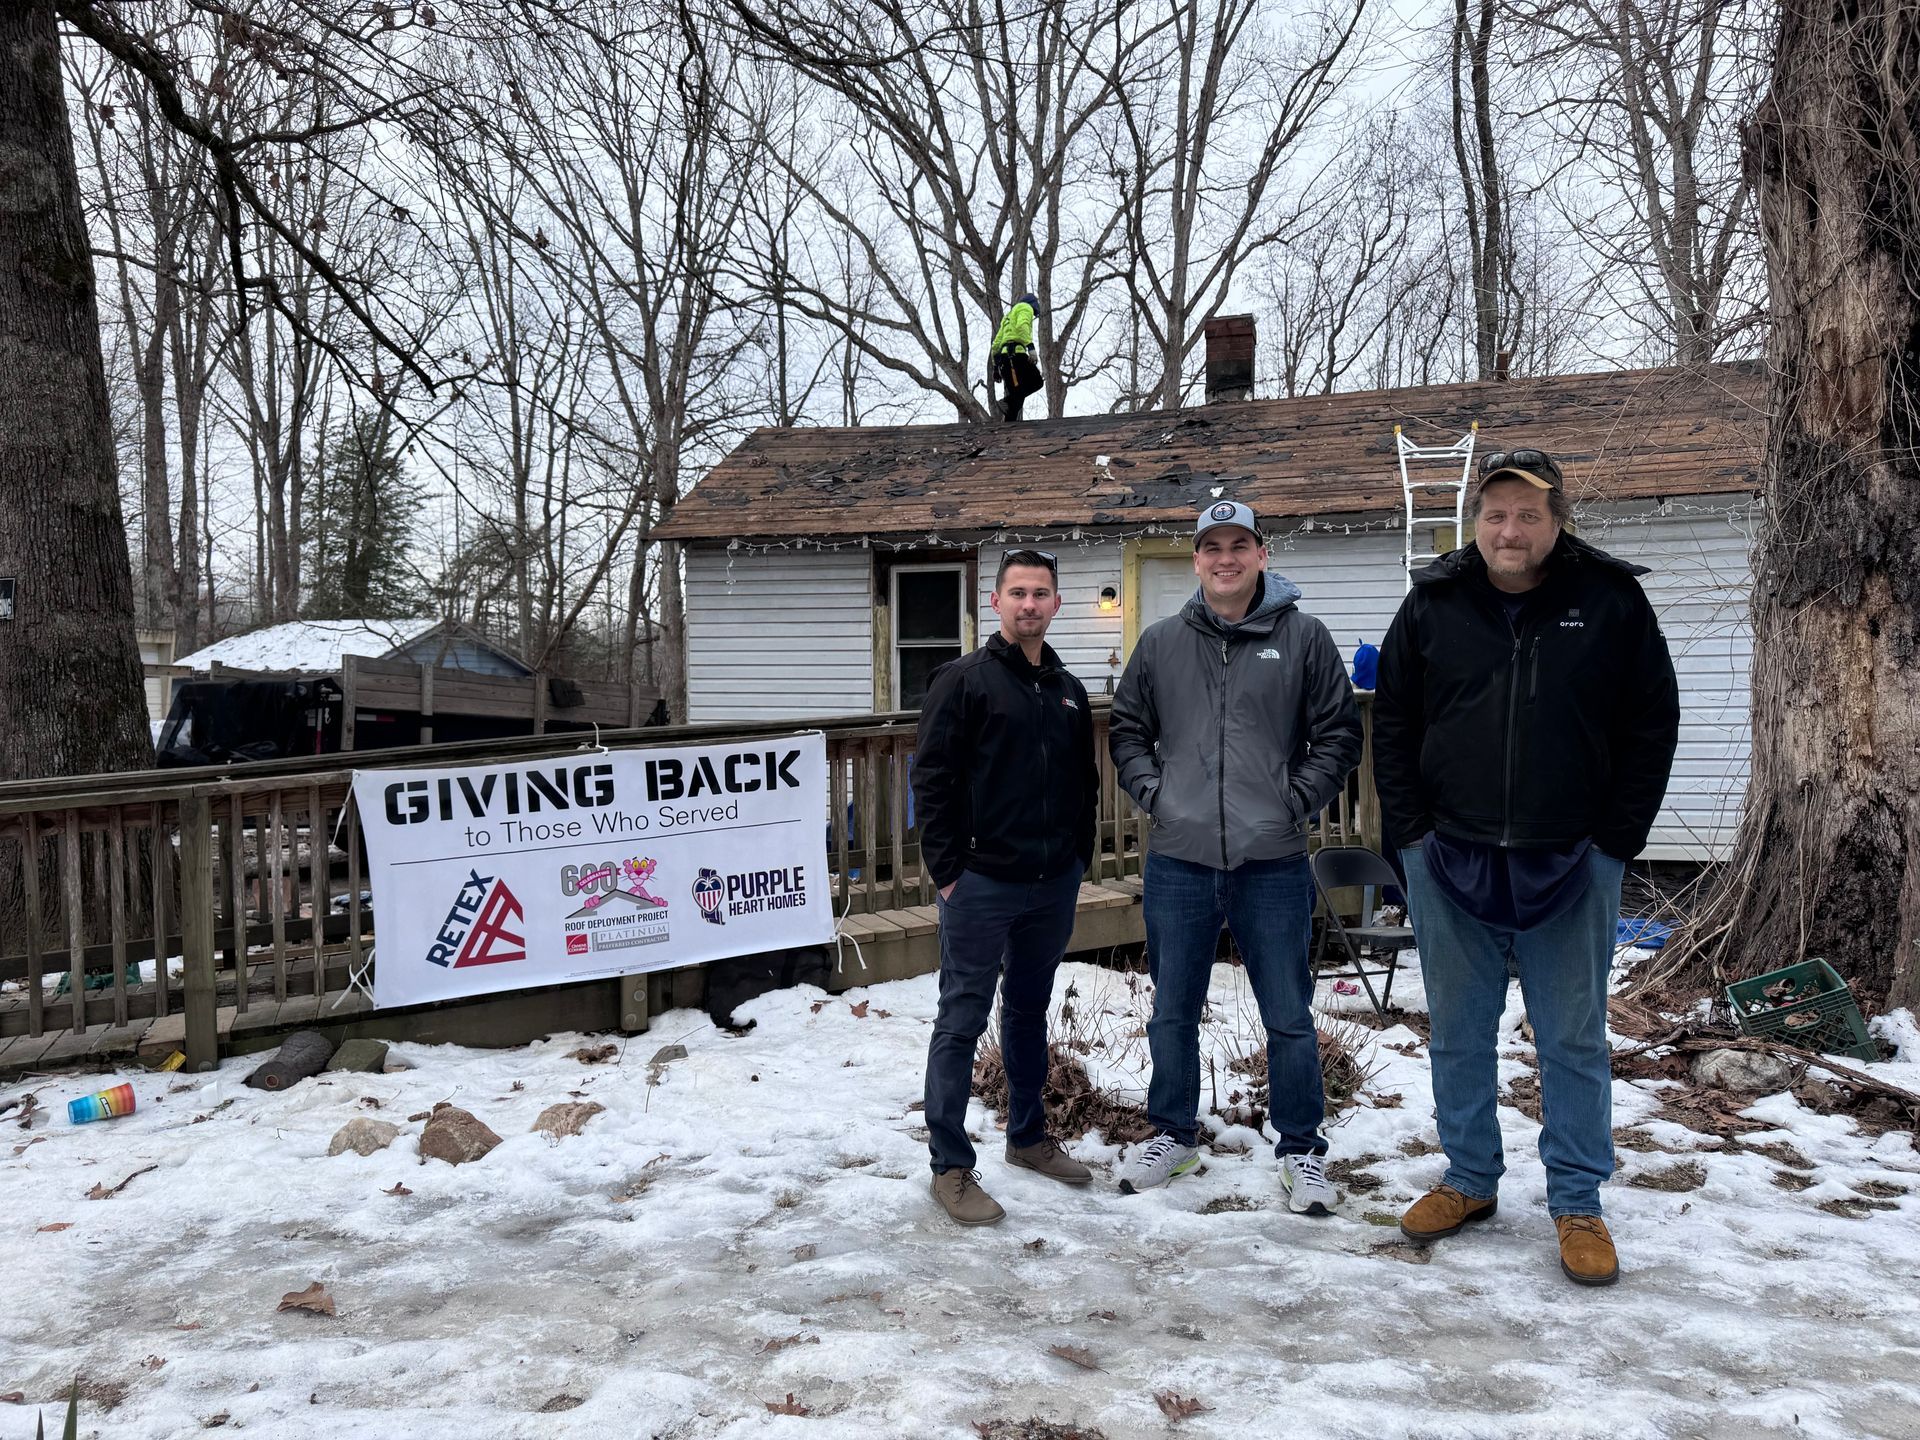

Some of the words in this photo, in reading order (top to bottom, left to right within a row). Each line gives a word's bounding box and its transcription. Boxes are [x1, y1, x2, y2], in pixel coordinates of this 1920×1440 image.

[384, 764, 615, 825] GIVING
[645, 750, 801, 801] BACK
[465, 826, 491, 847] to
[500, 820, 582, 843] Those
[592, 811, 649, 834] Who
[659, 800, 738, 827] Served
[561, 861, 618, 896] 600
[727, 866, 805, 901] PURPLE
[425, 868, 494, 968] RETEX
[564, 920, 586, 931] ROOF
[588, 914, 635, 929] DEPLOYMENT
[637, 910, 668, 922] PROJECT
[729, 898, 764, 916] HEART
[768, 892, 806, 910] HOMES
[600, 925, 667, 941] PLATINUM
